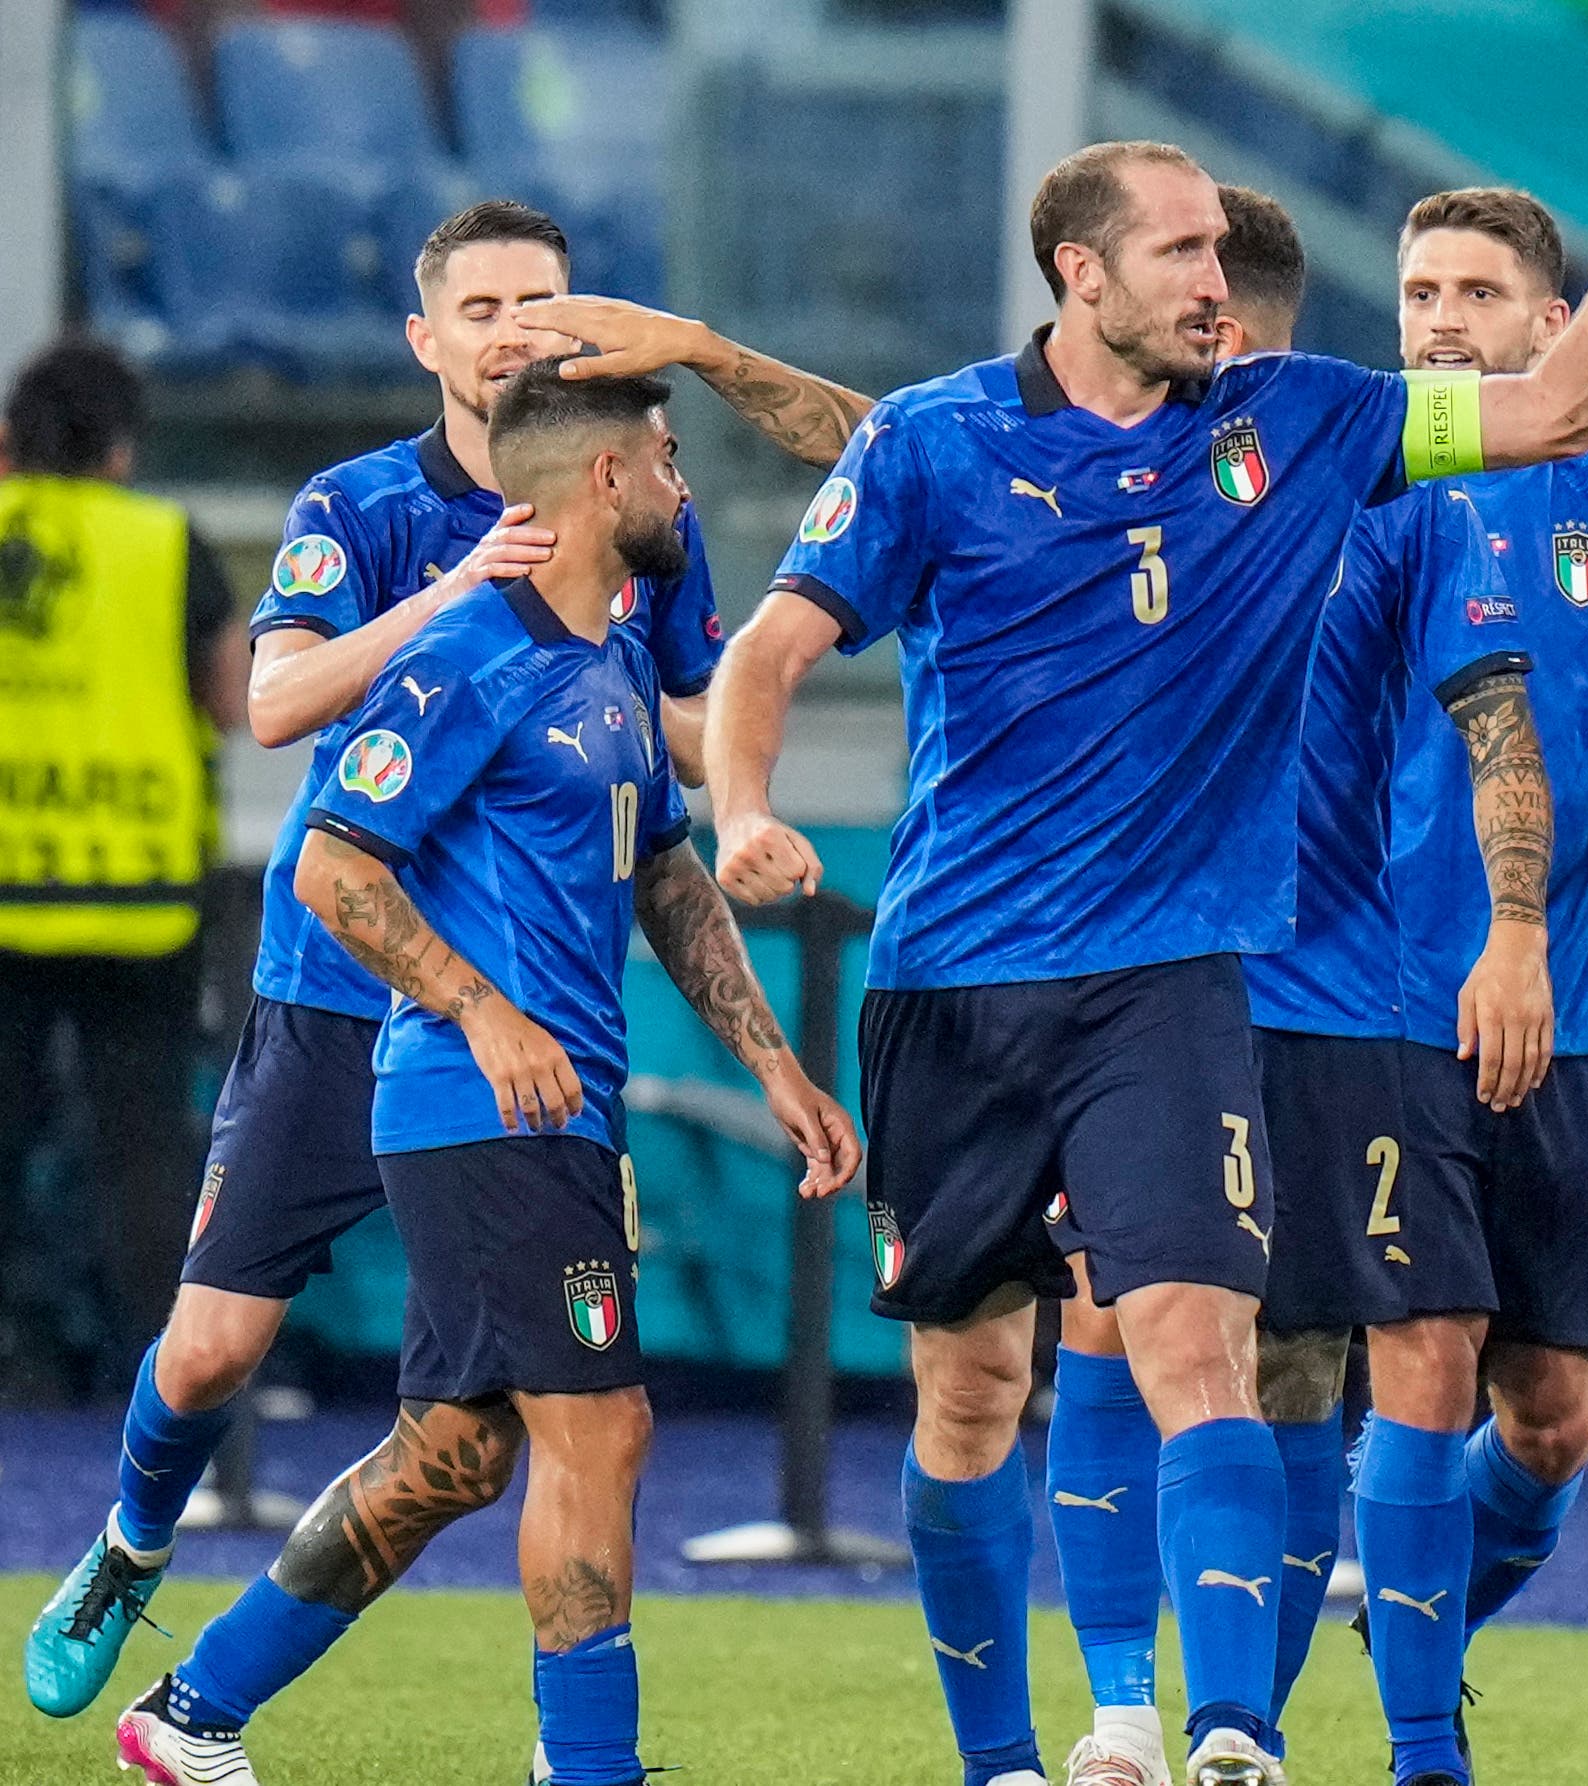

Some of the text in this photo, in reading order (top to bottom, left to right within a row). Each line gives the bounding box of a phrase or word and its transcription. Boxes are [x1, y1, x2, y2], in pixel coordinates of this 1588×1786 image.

[1215, 434, 1254, 456] ITALIA
[1126, 525, 1169, 625] 3
[610, 781, 638, 883] 10
[1221, 1111, 1255, 1209] 3
[1366, 1136, 1401, 1236] 2
[570, 1278, 612, 1295] ITALIA
